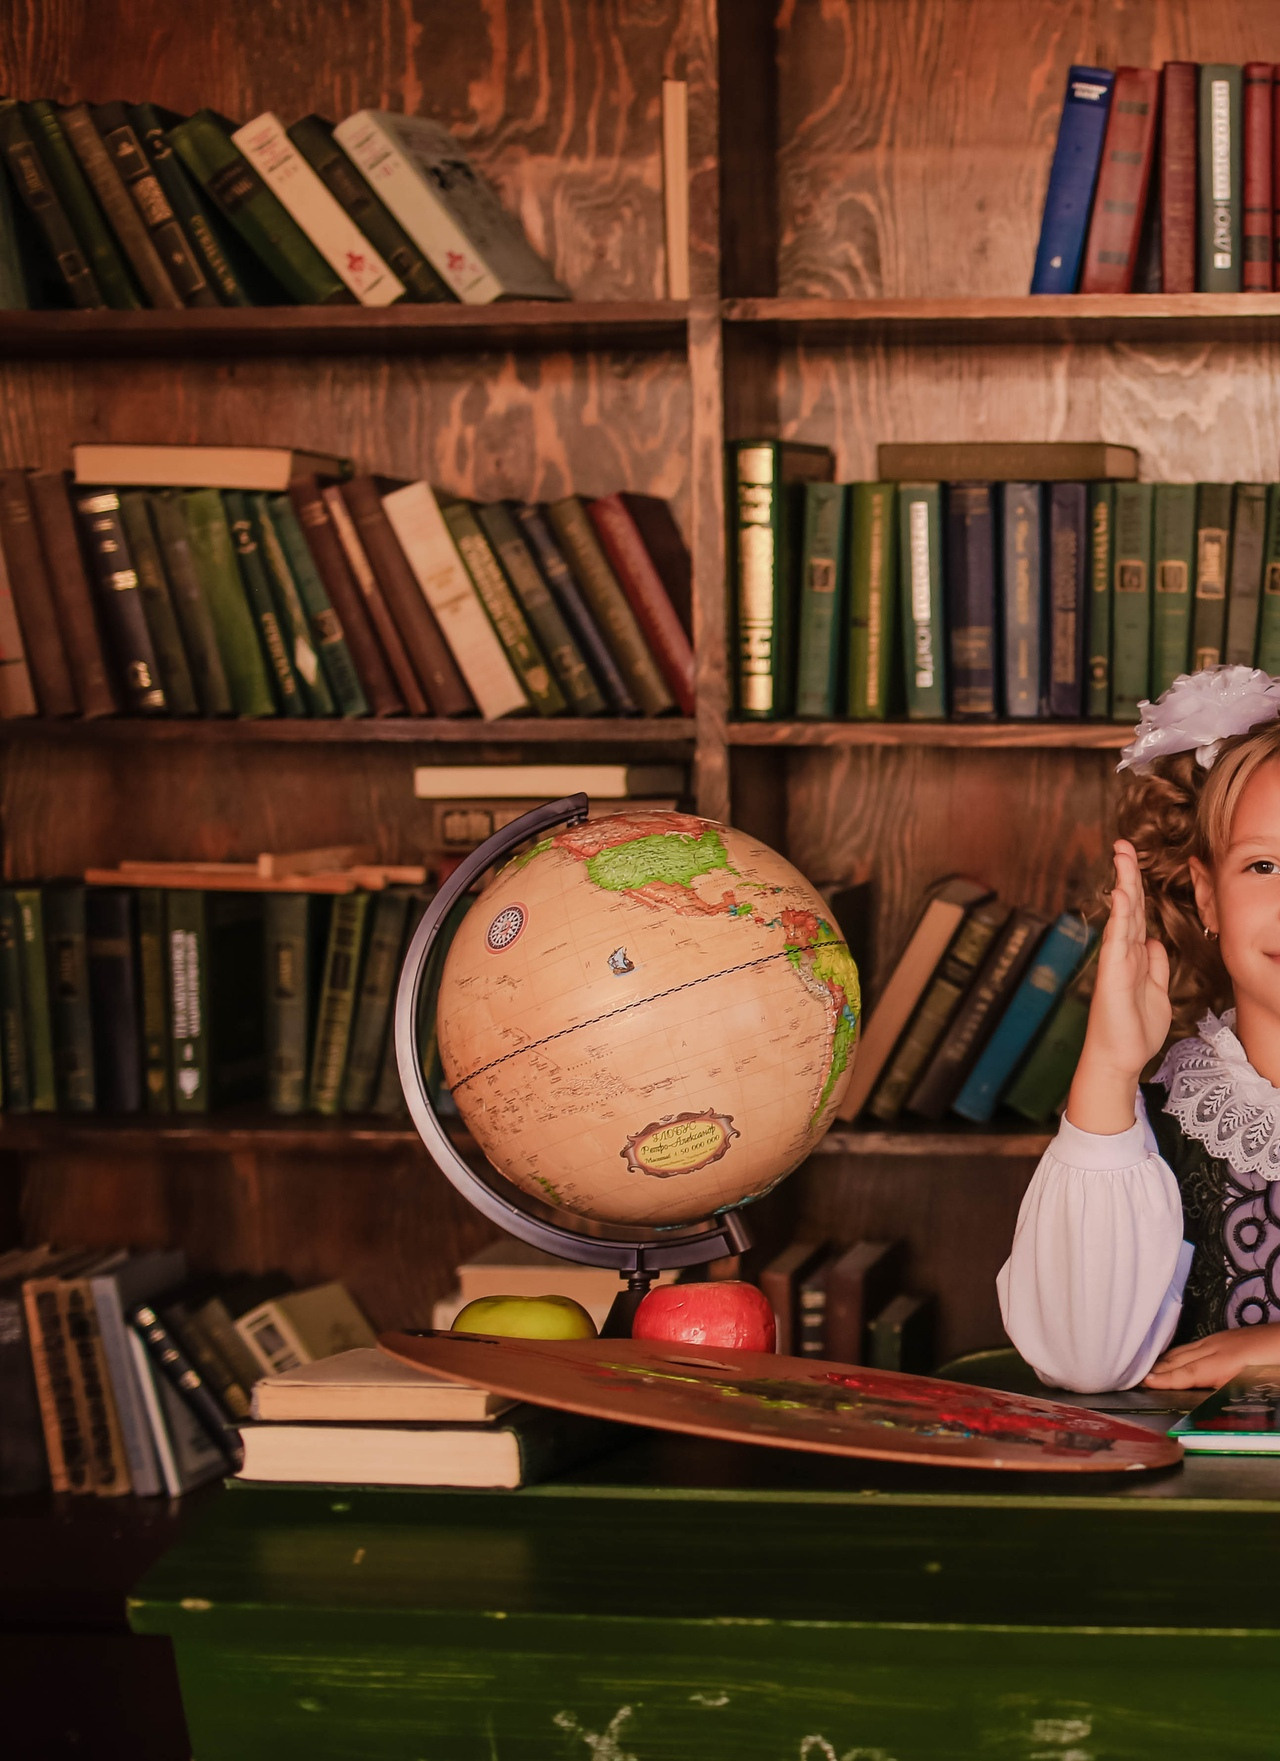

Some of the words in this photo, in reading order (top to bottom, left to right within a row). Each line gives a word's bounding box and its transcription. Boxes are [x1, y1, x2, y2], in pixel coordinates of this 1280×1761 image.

[642, 1123, 716, 1154] Ретро-Александр
[652, 1121, 697, 1142] ГЛОБУС
[692, 1142, 705, 1150] 000
[707, 1135, 720, 1143] 000
